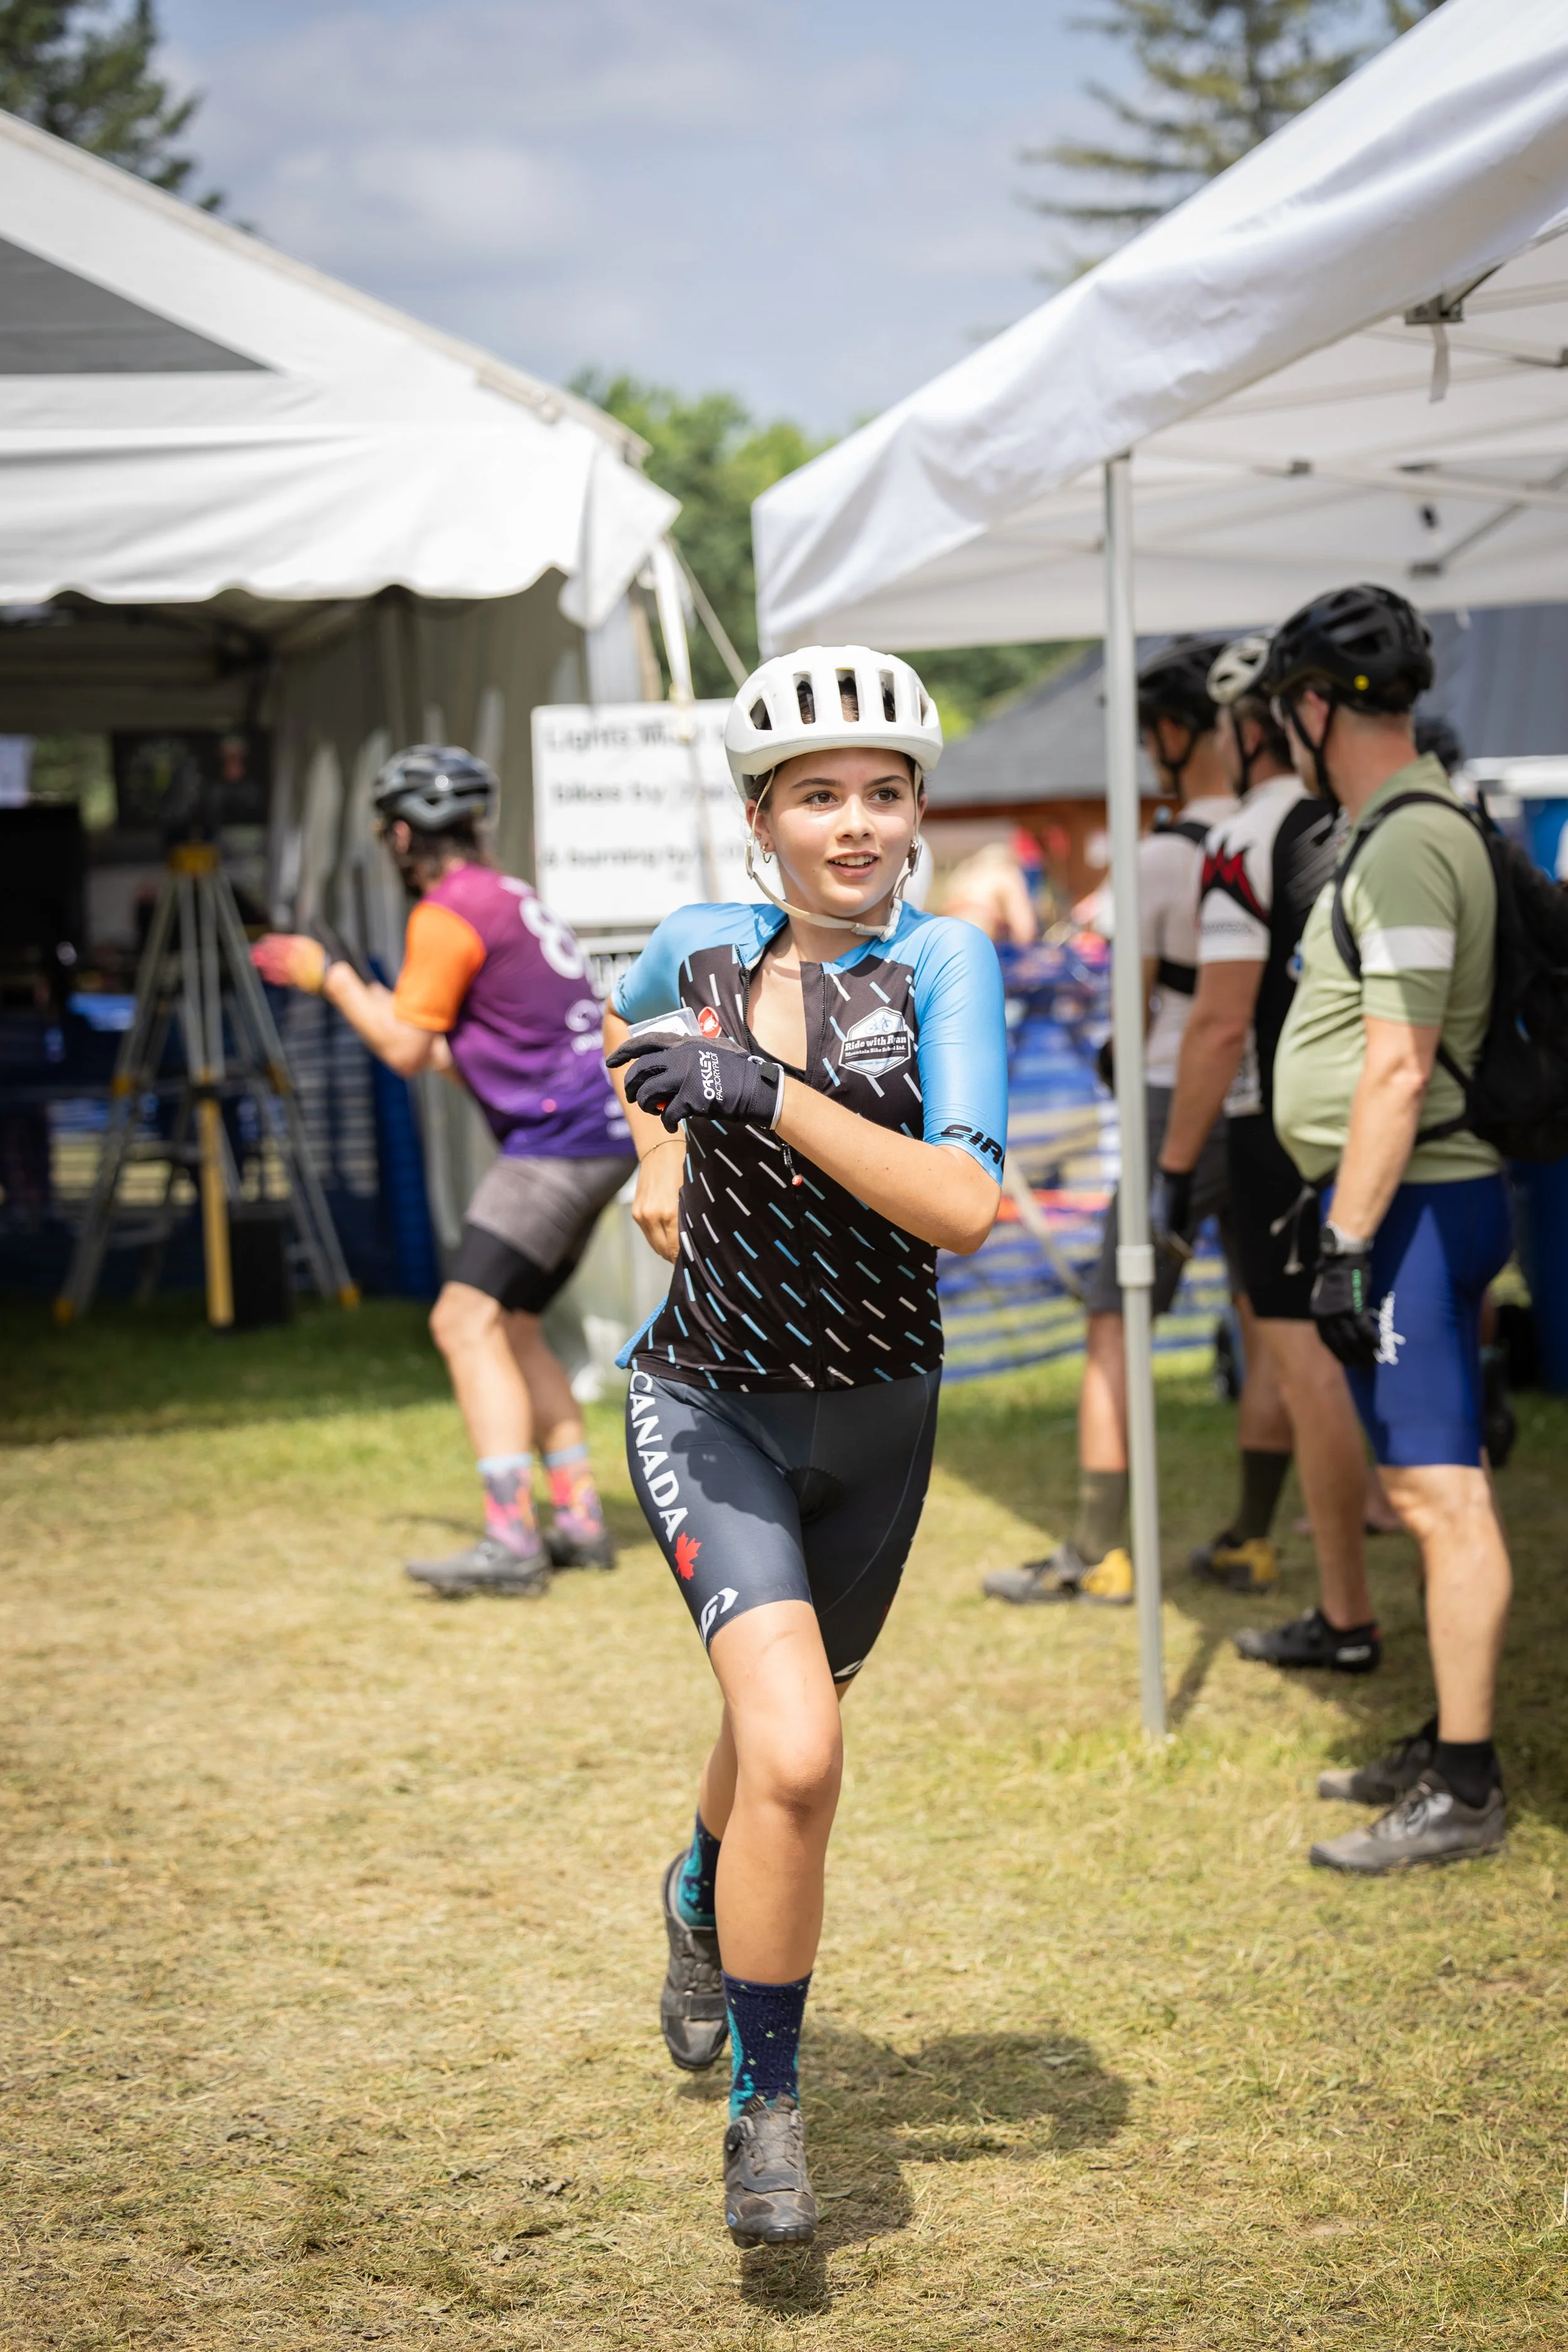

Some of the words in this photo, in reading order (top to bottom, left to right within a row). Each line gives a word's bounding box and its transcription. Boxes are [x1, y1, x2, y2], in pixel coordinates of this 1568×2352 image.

[844, 1041, 866, 1051] Ride
[866, 1036, 886, 1047] with
[845, 1049, 870, 1057] Mountain
[698, 1050, 716, 1100] OAKLEY
[629, 1370, 689, 1543] CANADA
